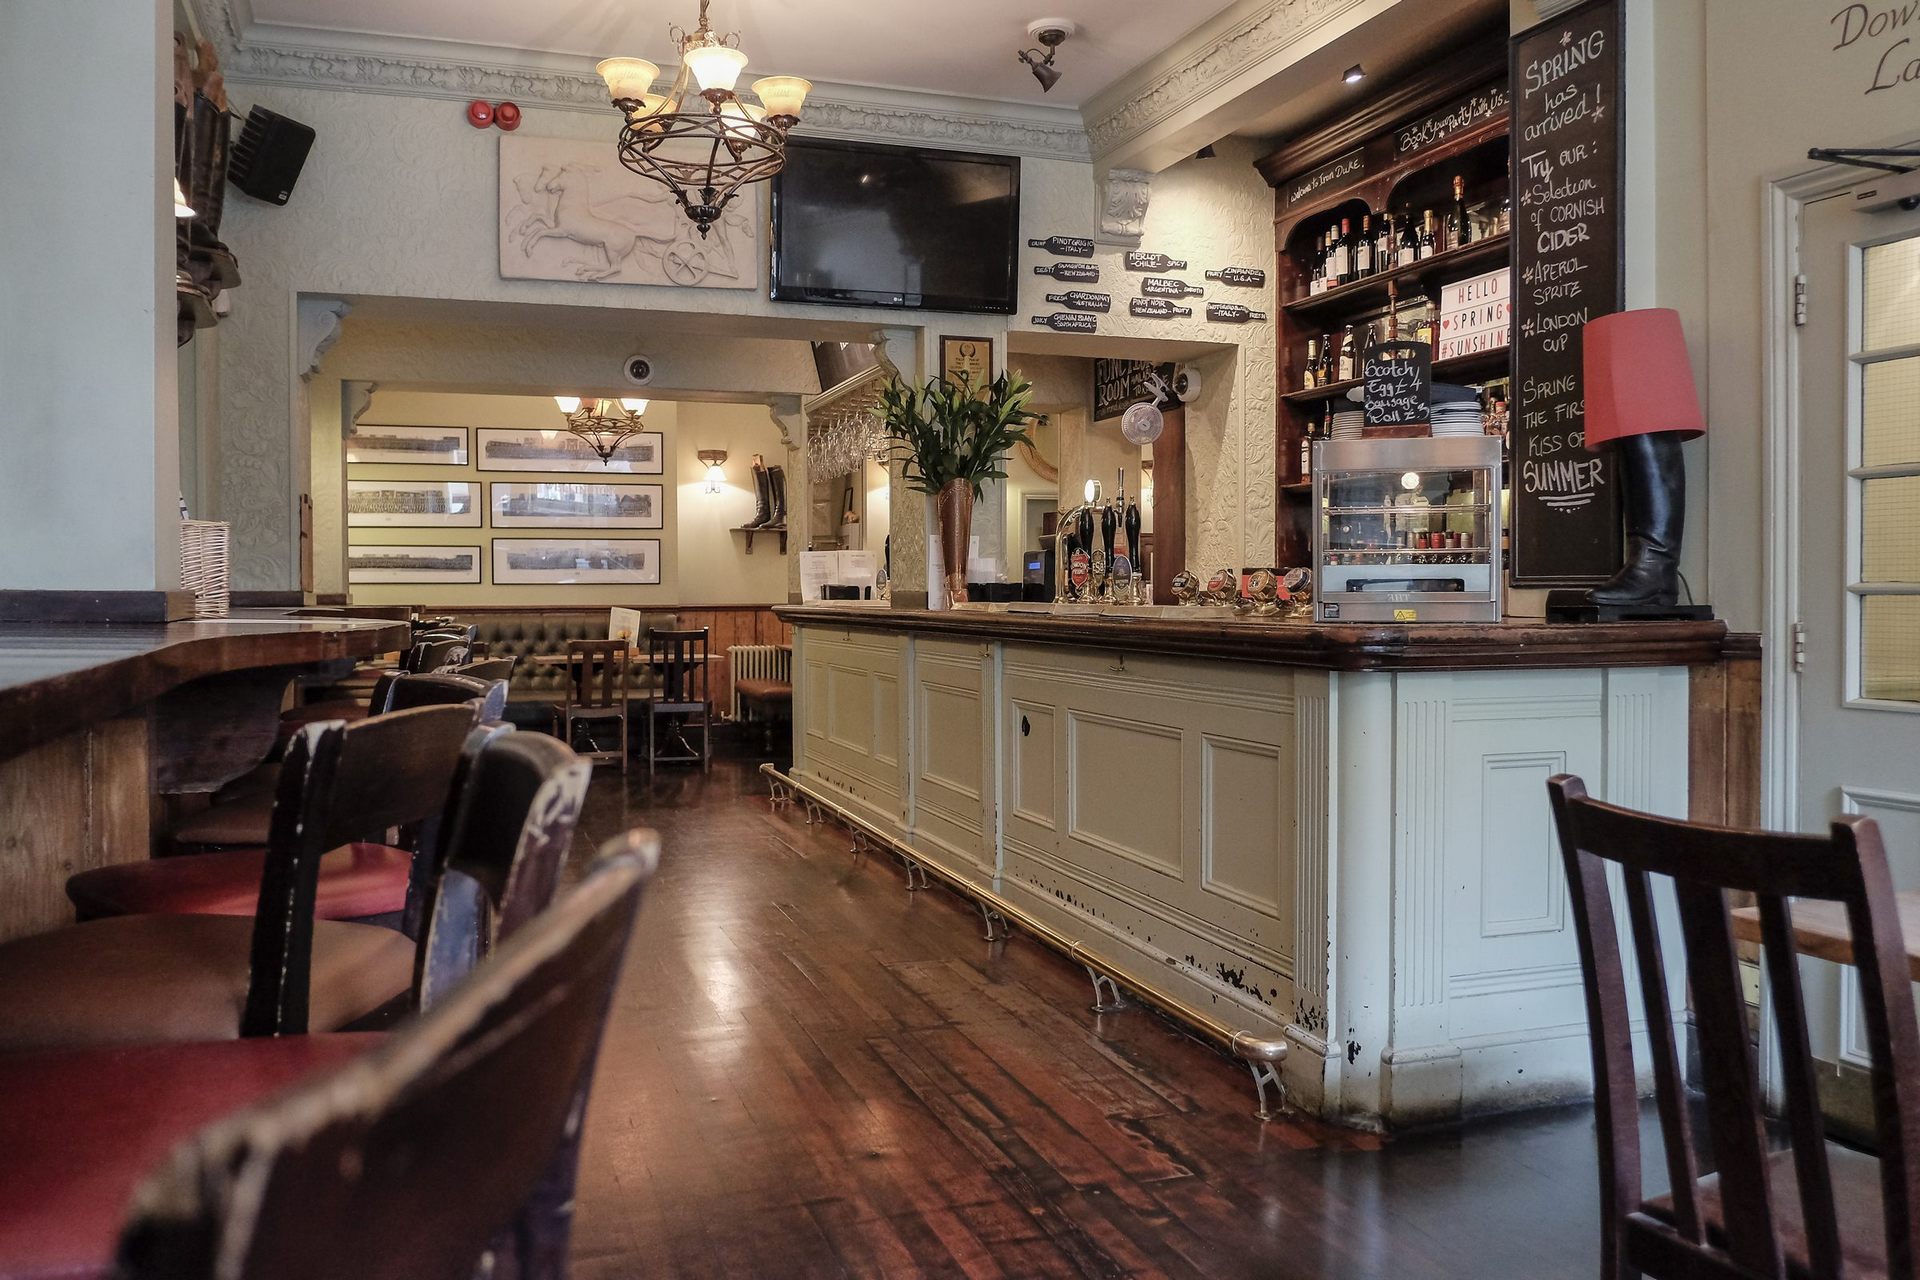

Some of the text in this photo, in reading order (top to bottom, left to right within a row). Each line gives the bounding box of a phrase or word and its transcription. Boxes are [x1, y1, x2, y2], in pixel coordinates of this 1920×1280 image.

[1831, 0, 1920, 51] Dow
[1525, 30, 1605, 99] SPRING
[1864, 37, 1920, 95] La
[1545, 83, 1578, 113] has
[1521, 150, 1554, 183] Try
[1530, 197, 1605, 232] of CORNISH
[1537, 222, 1591, 253] CIDER
[1129, 252, 1161, 262] MERLOT
[1534, 257, 1588, 285] APEROL
[1147, 279, 1180, 288] MALBEC
[1458, 277, 1498, 304] HELLO
[1453, 303, 1503, 331] SPRING
[1536, 307, 1588, 333] LONDON
[1543, 333, 1568, 352] CUP
[1099, 375, 1130, 407] ROOM
[1366, 378, 1393, 397] Egg
[1523, 375, 1576, 406] SPRING
[1366, 406, 1401, 423] Roll
[1523, 400, 1585, 430] THE FIRS
[1523, 458, 1605, 493] SUMMER
